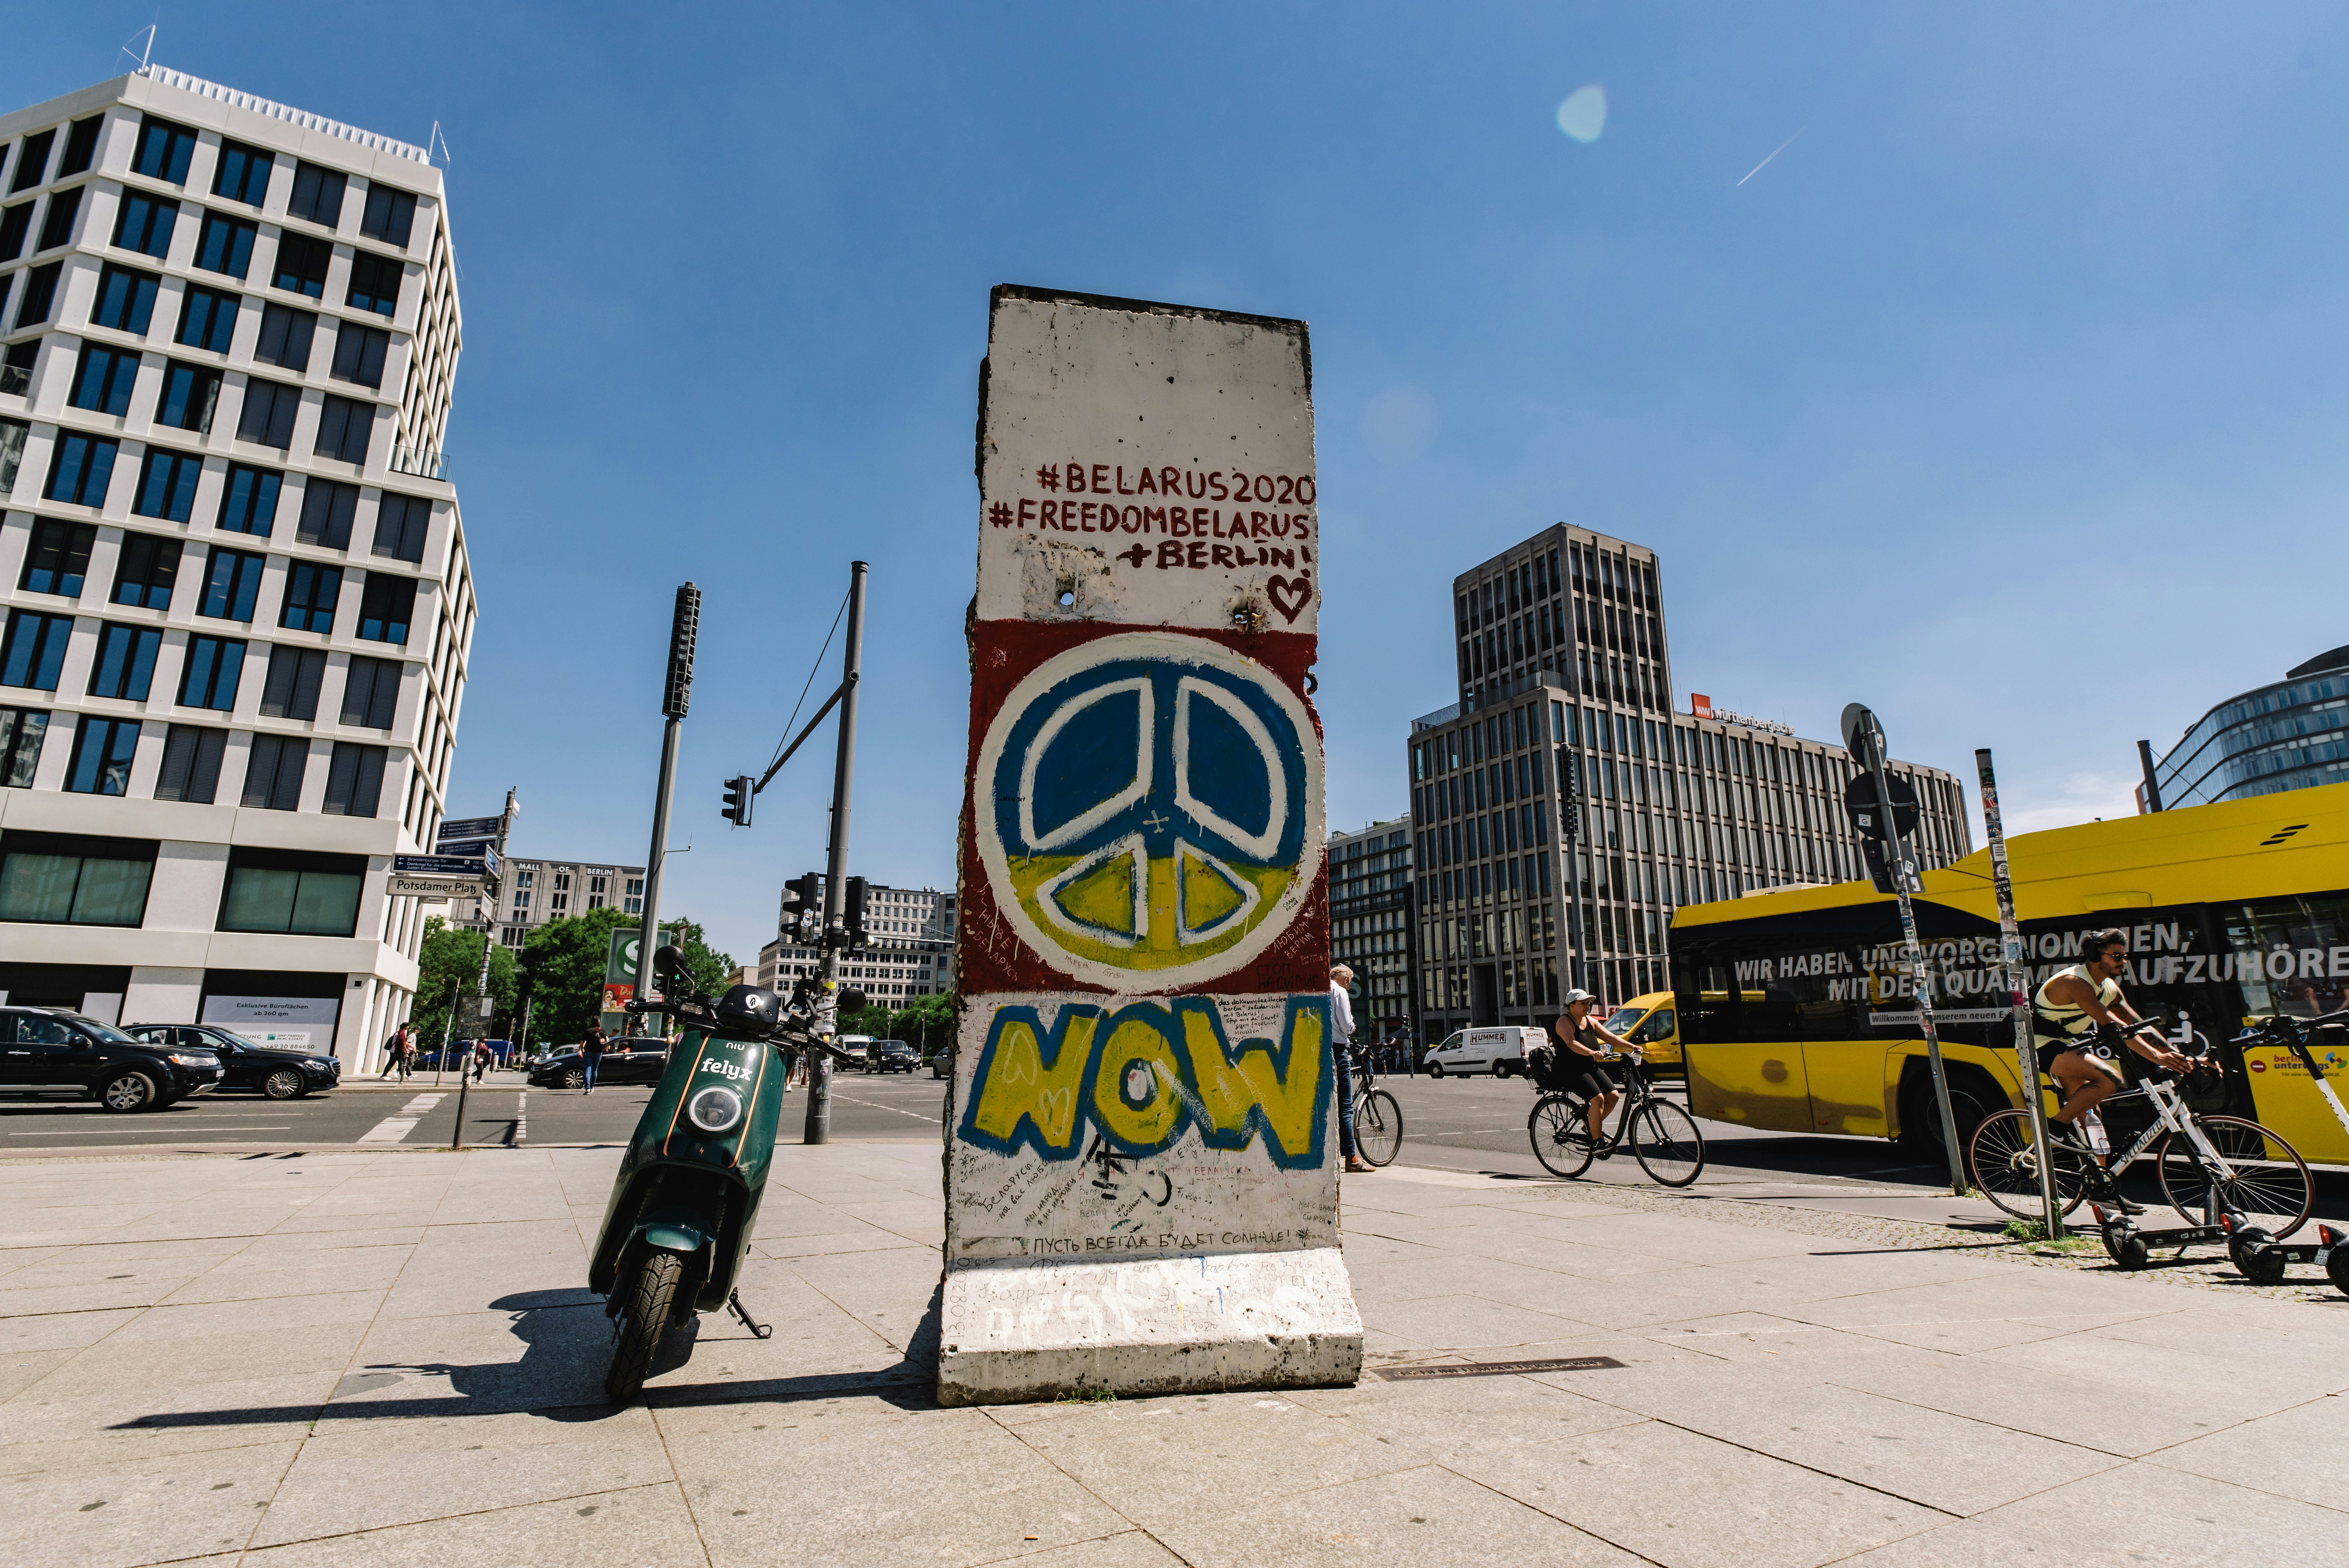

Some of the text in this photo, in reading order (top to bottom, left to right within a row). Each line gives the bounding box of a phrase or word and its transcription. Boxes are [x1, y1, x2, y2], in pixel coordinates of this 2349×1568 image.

[1036, 462, 1316, 506] #BELARUS2020
[988, 498, 1310, 540] #FREEDOMBELARUS
[397, 880, 476, 895] Potsdamer Platz
[1274, 921, 1309, 953] ЛЮБИМ
[1285, 932, 1314, 959] ВЕРИМ
[1256, 963, 1291, 975] СТОП
[1734, 959, 1773, 981] WIR
[1779, 952, 1853, 978] HABEN
[1862, 946, 1912, 971] UNS
[1829, 976, 1871, 1001] MIT
[1871, 1011, 1996, 1023] Willkommen unserem neuen
[1472, 1033, 1505, 1043] HUMMER
[701, 1058, 753, 1081] felyx
[957, 995, 1333, 1171] NOW
[2120, 1120, 2163, 1166] SPECIALIZED
[1034, 1237, 1080, 1253] ПУСТЬ
[1086, 1235, 1148, 1250] ВСЕГДА
[1159, 1232, 1214, 1249] БУДЕТ
